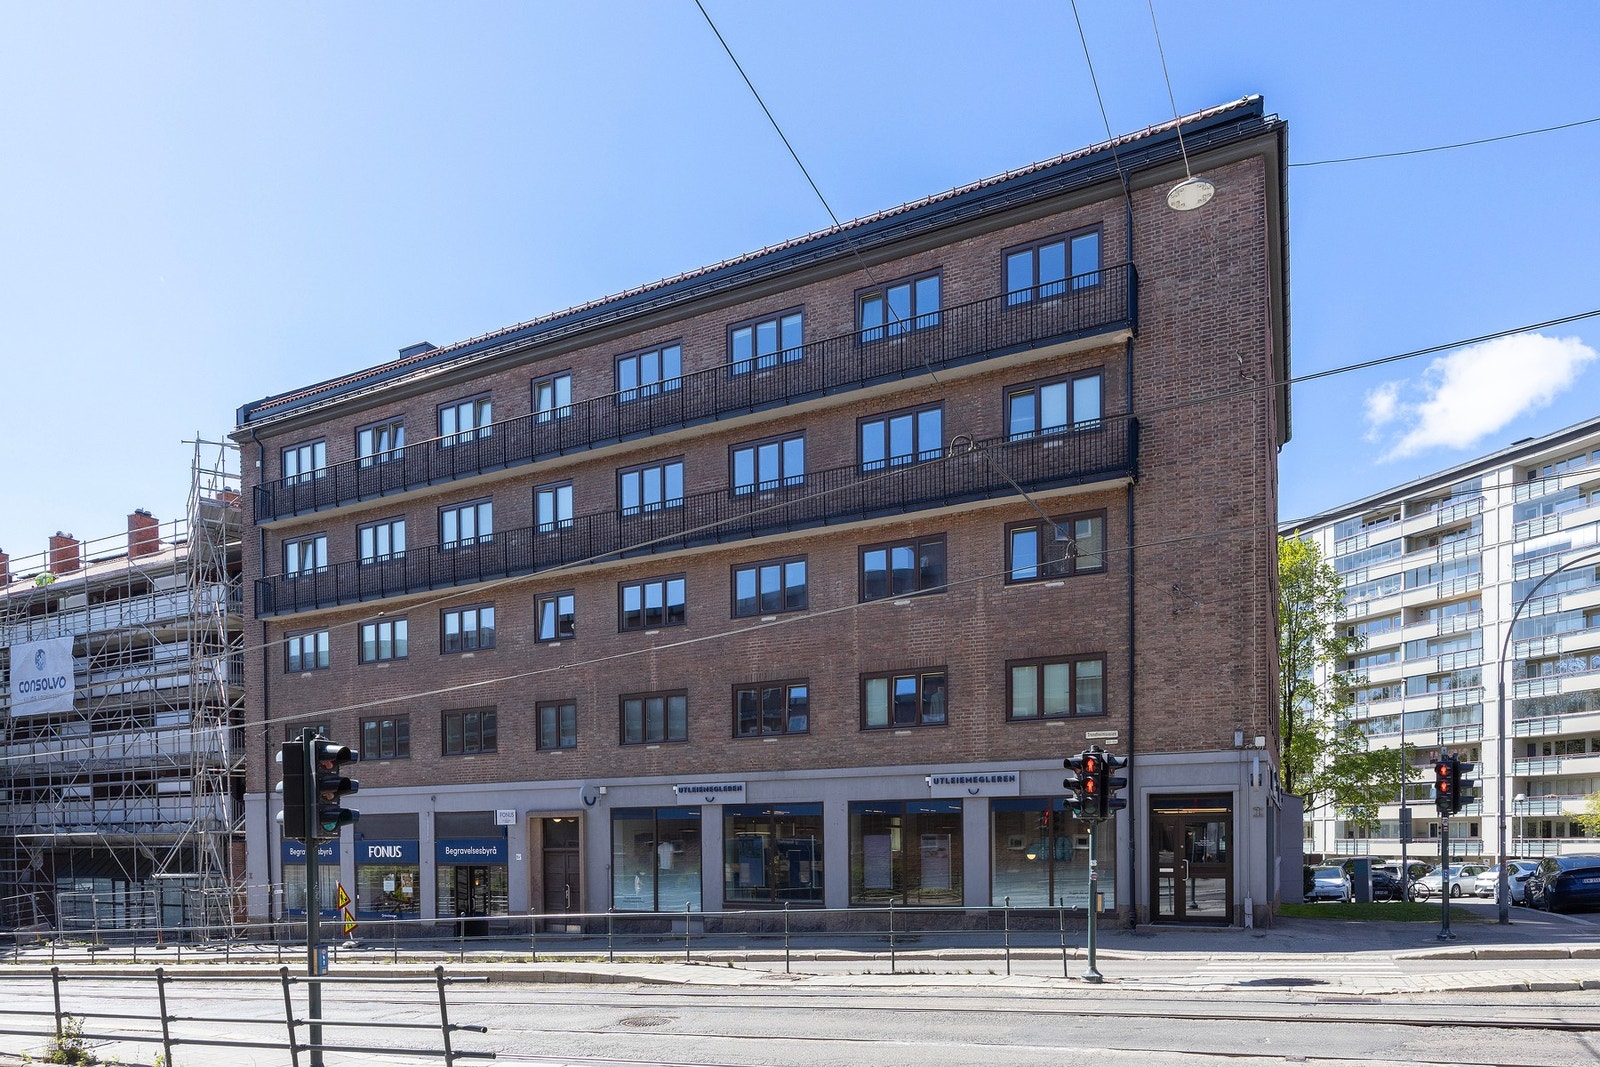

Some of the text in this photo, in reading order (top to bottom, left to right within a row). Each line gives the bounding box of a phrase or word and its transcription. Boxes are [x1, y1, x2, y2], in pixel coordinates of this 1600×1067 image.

[19, 675, 67, 693] CONSOLVO
[933, 775, 1016, 784] UTLEIEMEGLEREN
[289, 847, 333, 857] Begrasbyrå
[368, 845, 402, 858] FONUS
[445, 846, 497, 857] Begravelsesbyrå
